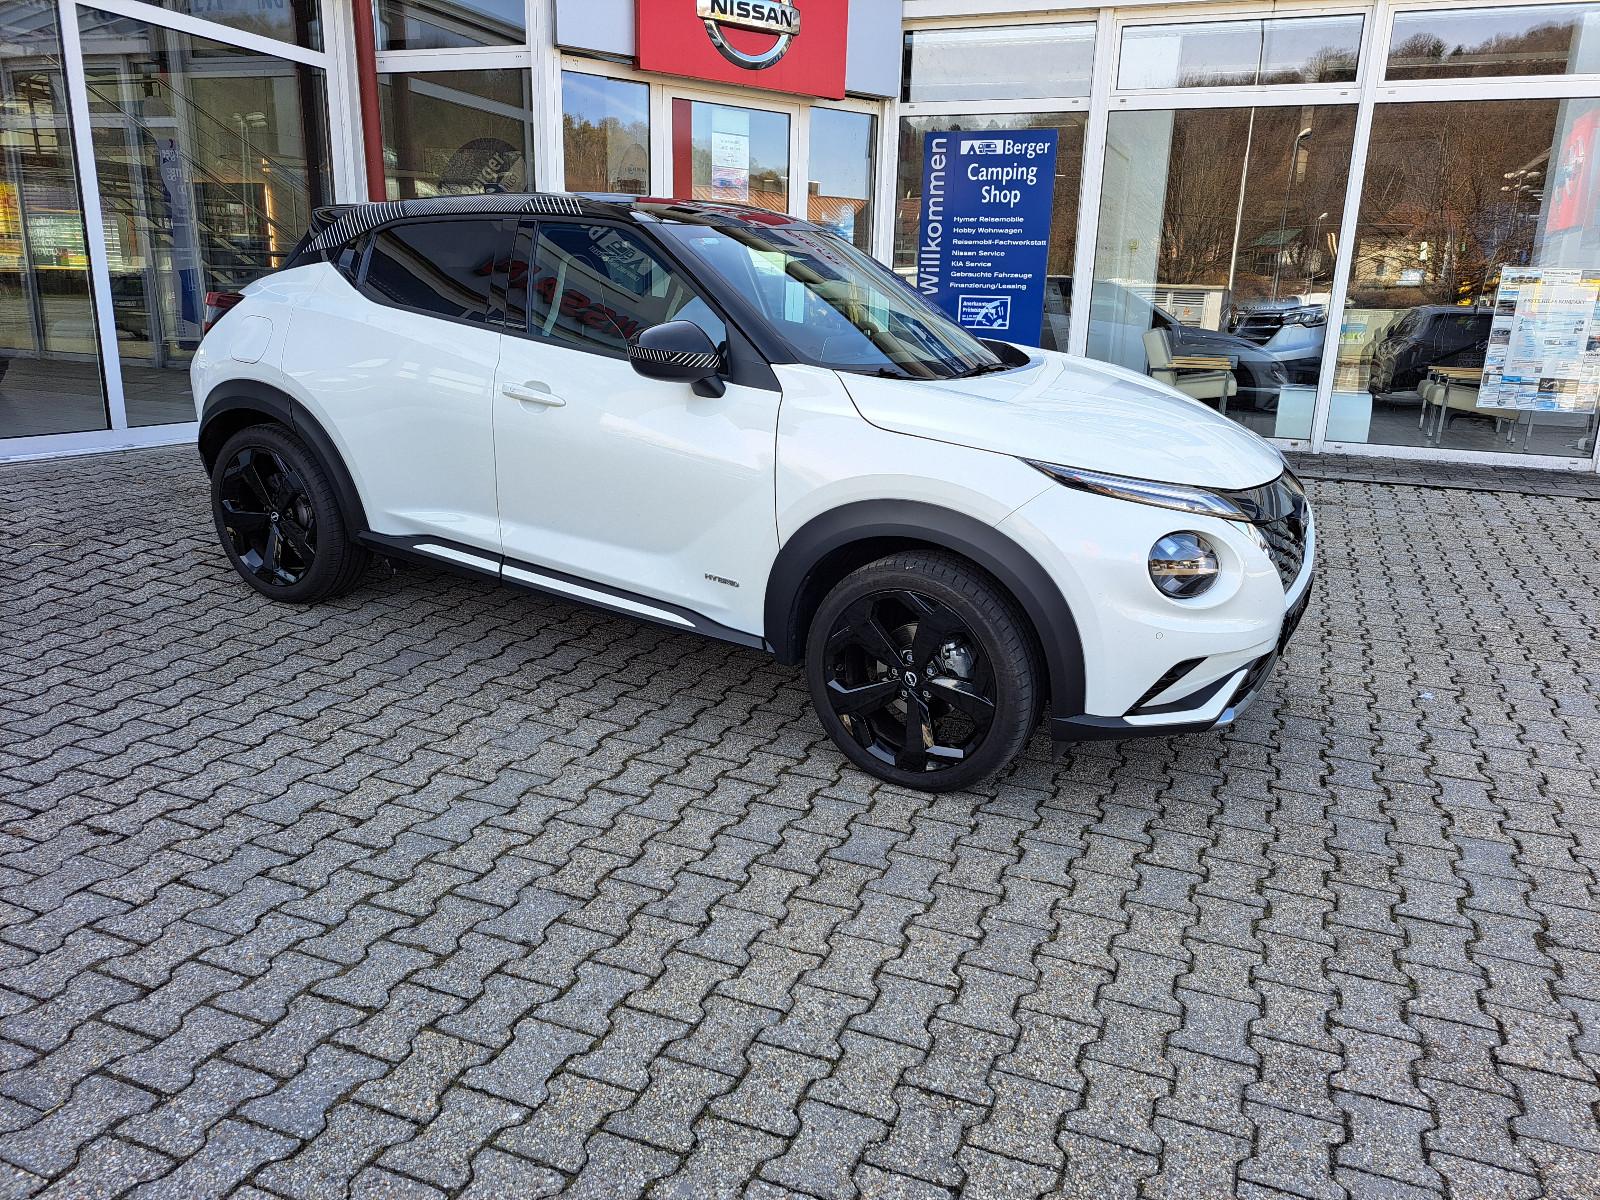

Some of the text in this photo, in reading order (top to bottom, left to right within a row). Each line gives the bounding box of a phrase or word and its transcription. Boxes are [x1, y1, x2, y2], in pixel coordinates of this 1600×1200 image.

[710, 0, 793, 28] NISSAN
[1004, 139, 1051, 159] Berger
[967, 162, 1038, 185] Camping
[981, 184, 1021, 208] Shop
[918, 137, 948, 296] Willkommen
[953, 227, 1023, 235] Hobby Wohnwagen
[952, 238, 1047, 246] Reisemobil-Fachwerkstatt
[978, 249, 1006, 257] Service
[951, 260, 993, 268] KIA Service
[950, 270, 1034, 280] Gebrauchte Fahrzeuge
[949, 282, 1028, 291] Finanzierung/Leasing
